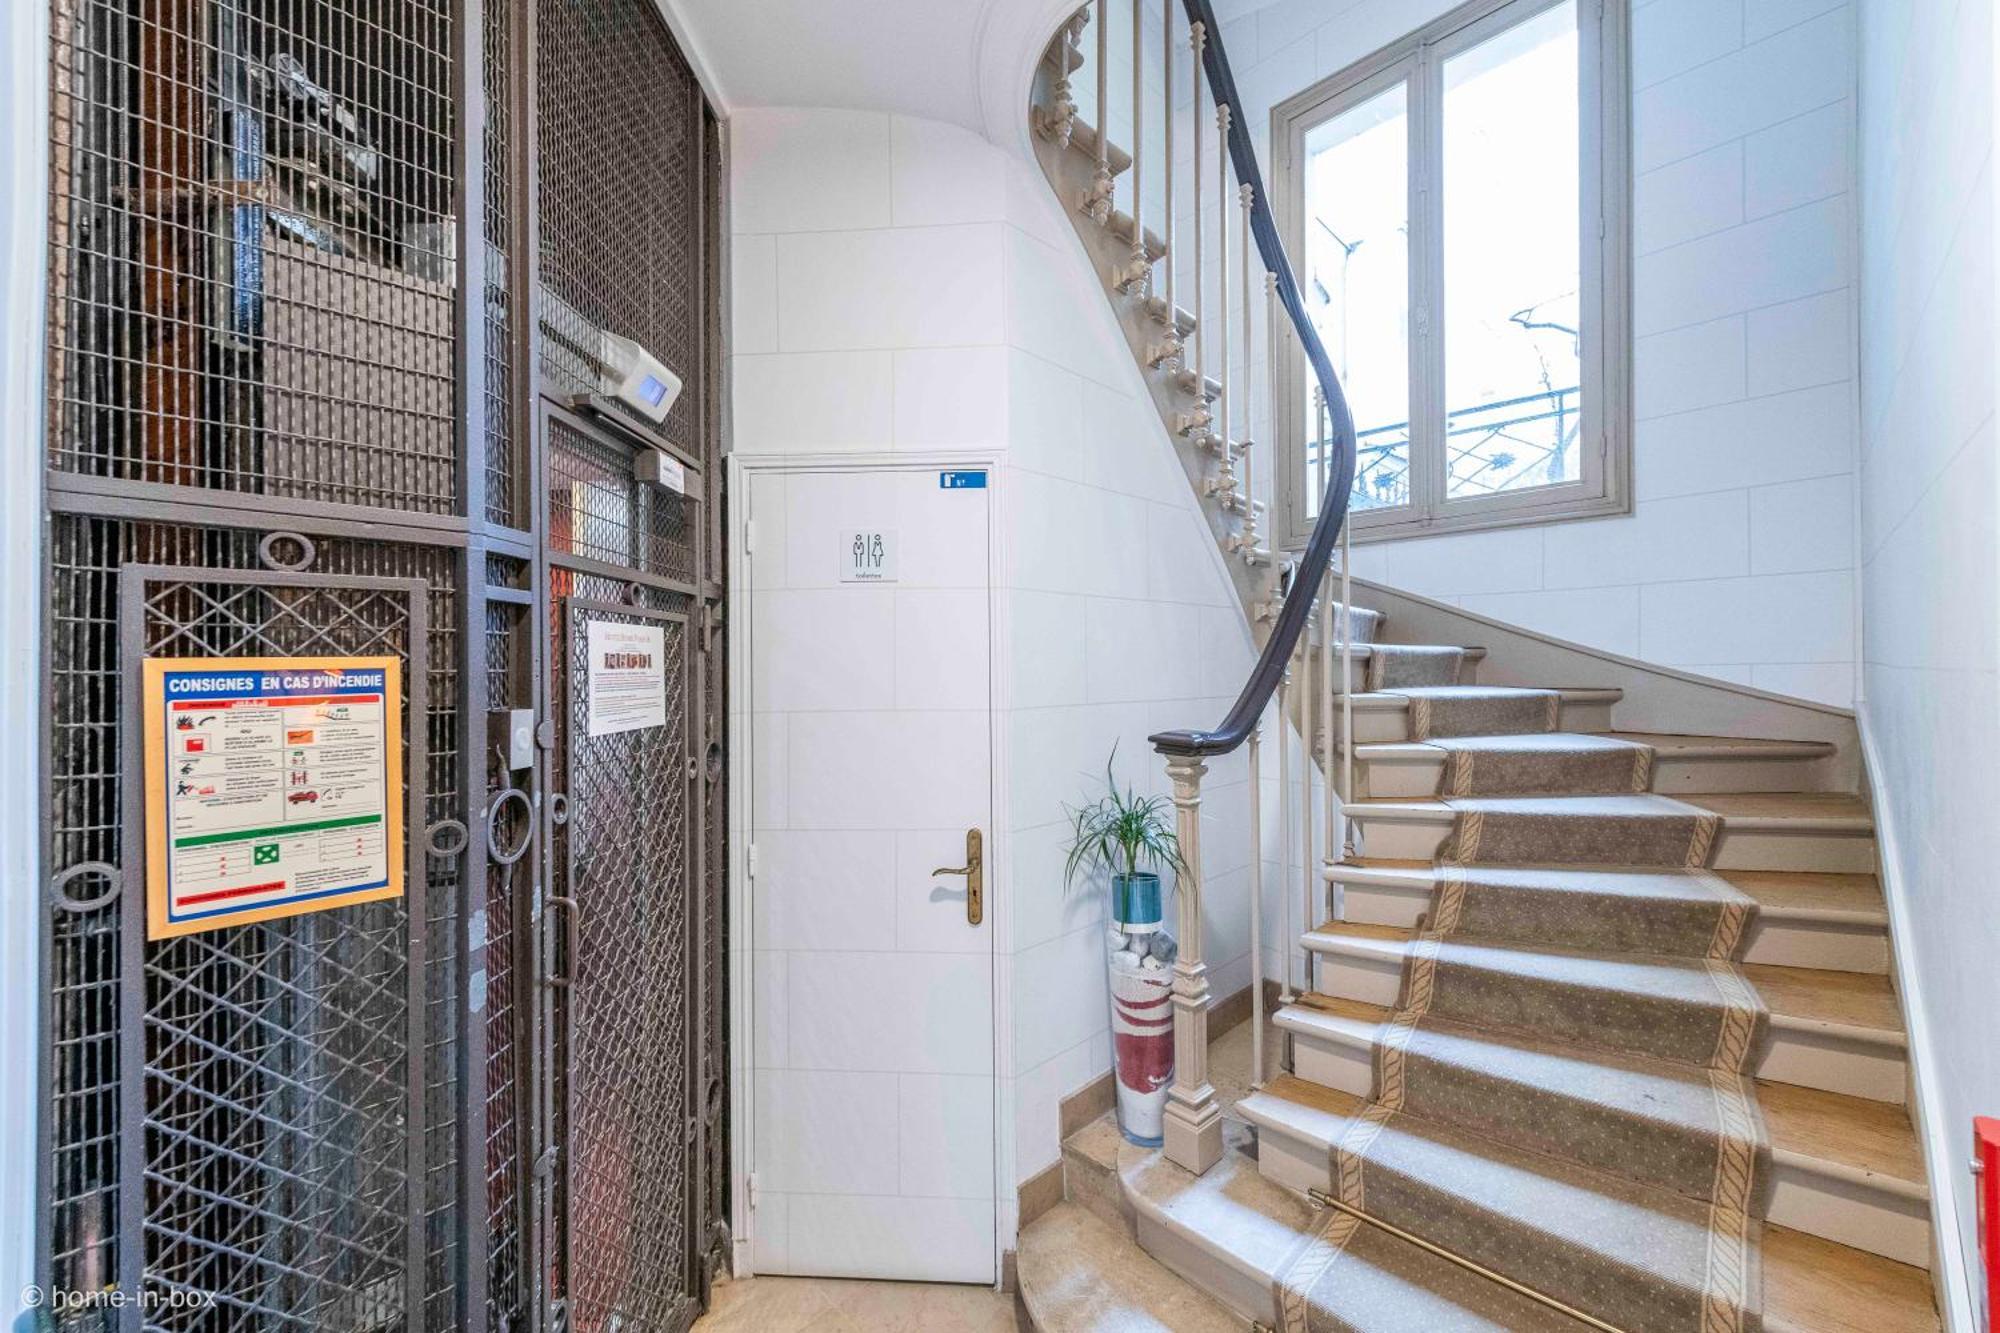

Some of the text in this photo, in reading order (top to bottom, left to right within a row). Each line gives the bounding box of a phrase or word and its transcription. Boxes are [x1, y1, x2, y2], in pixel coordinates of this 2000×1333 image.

[169, 674, 382, 693] CONSIGNES EN CAS D'INCENDIE
